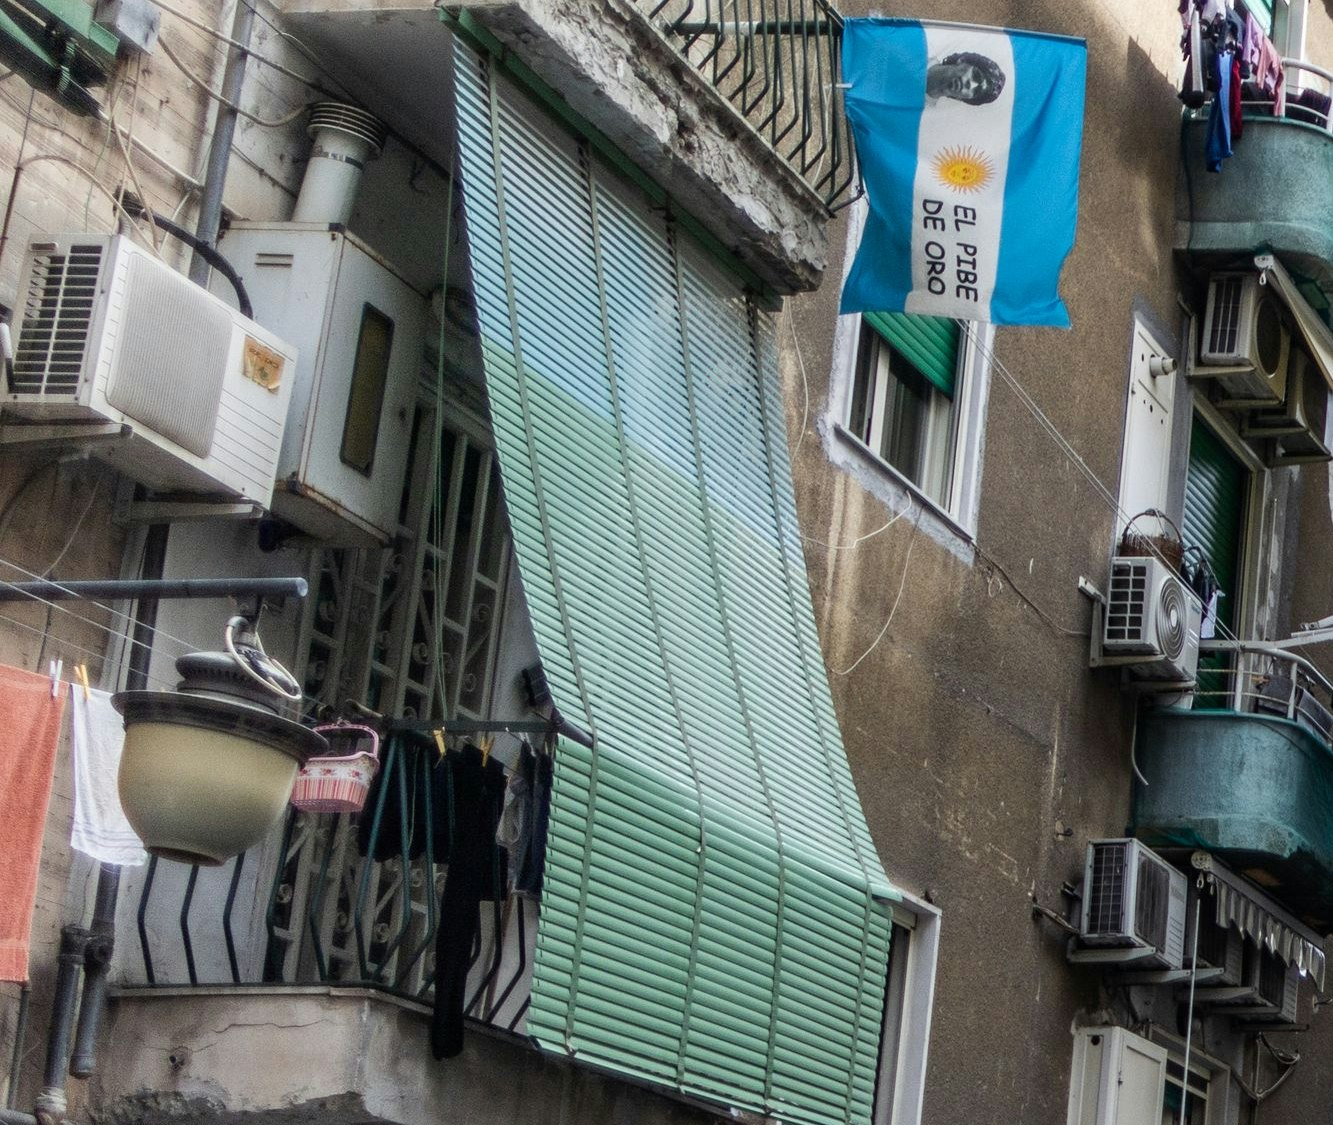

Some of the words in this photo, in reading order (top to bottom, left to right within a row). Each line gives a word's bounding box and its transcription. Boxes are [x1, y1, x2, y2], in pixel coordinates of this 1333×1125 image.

[923, 199, 946, 231] DE
[954, 204, 976, 232] EL
[925, 241, 946, 295] ORO
[956, 243, 978, 302] PIBE
